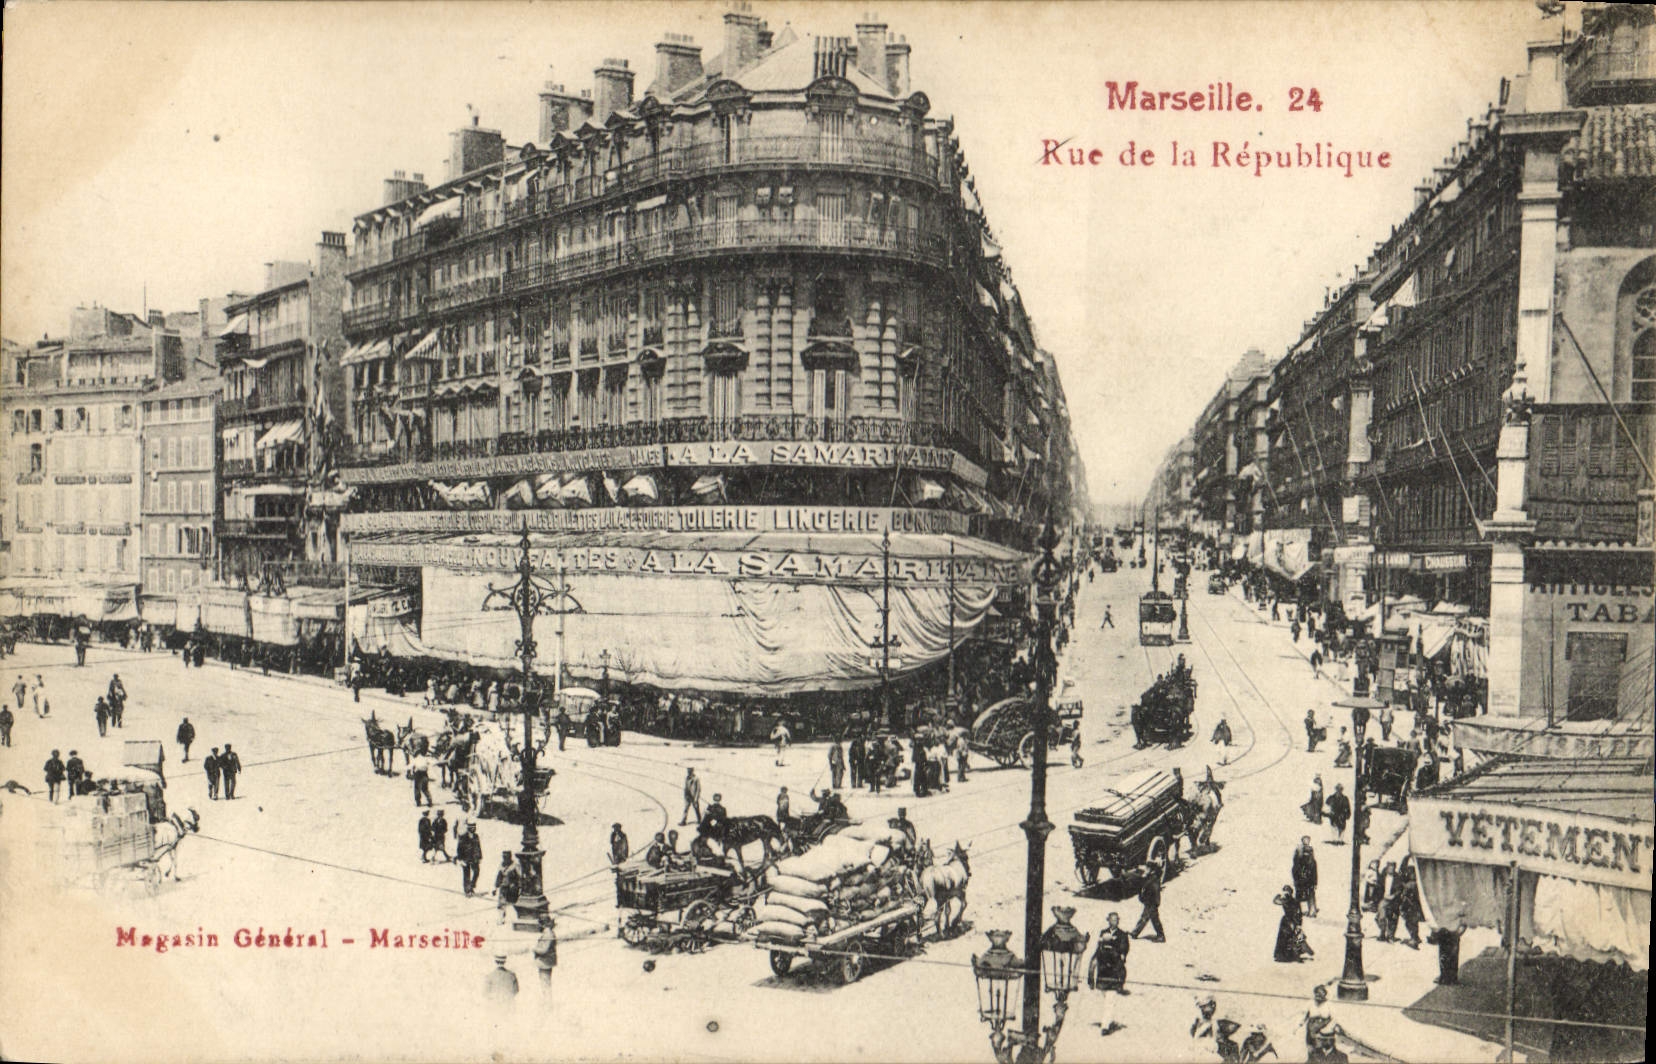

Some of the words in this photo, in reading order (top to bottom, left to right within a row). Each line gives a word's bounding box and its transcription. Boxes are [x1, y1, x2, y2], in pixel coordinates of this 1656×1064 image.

[709, 443, 758, 464] LA
[770, 442, 954, 469] SAMARITAINE
[678, 508, 757, 530] TOILERIE
[773, 508, 878, 532] LINGERIE
[669, 552, 728, 575] LA
[738, 552, 1019, 583] SAMARITAINE
